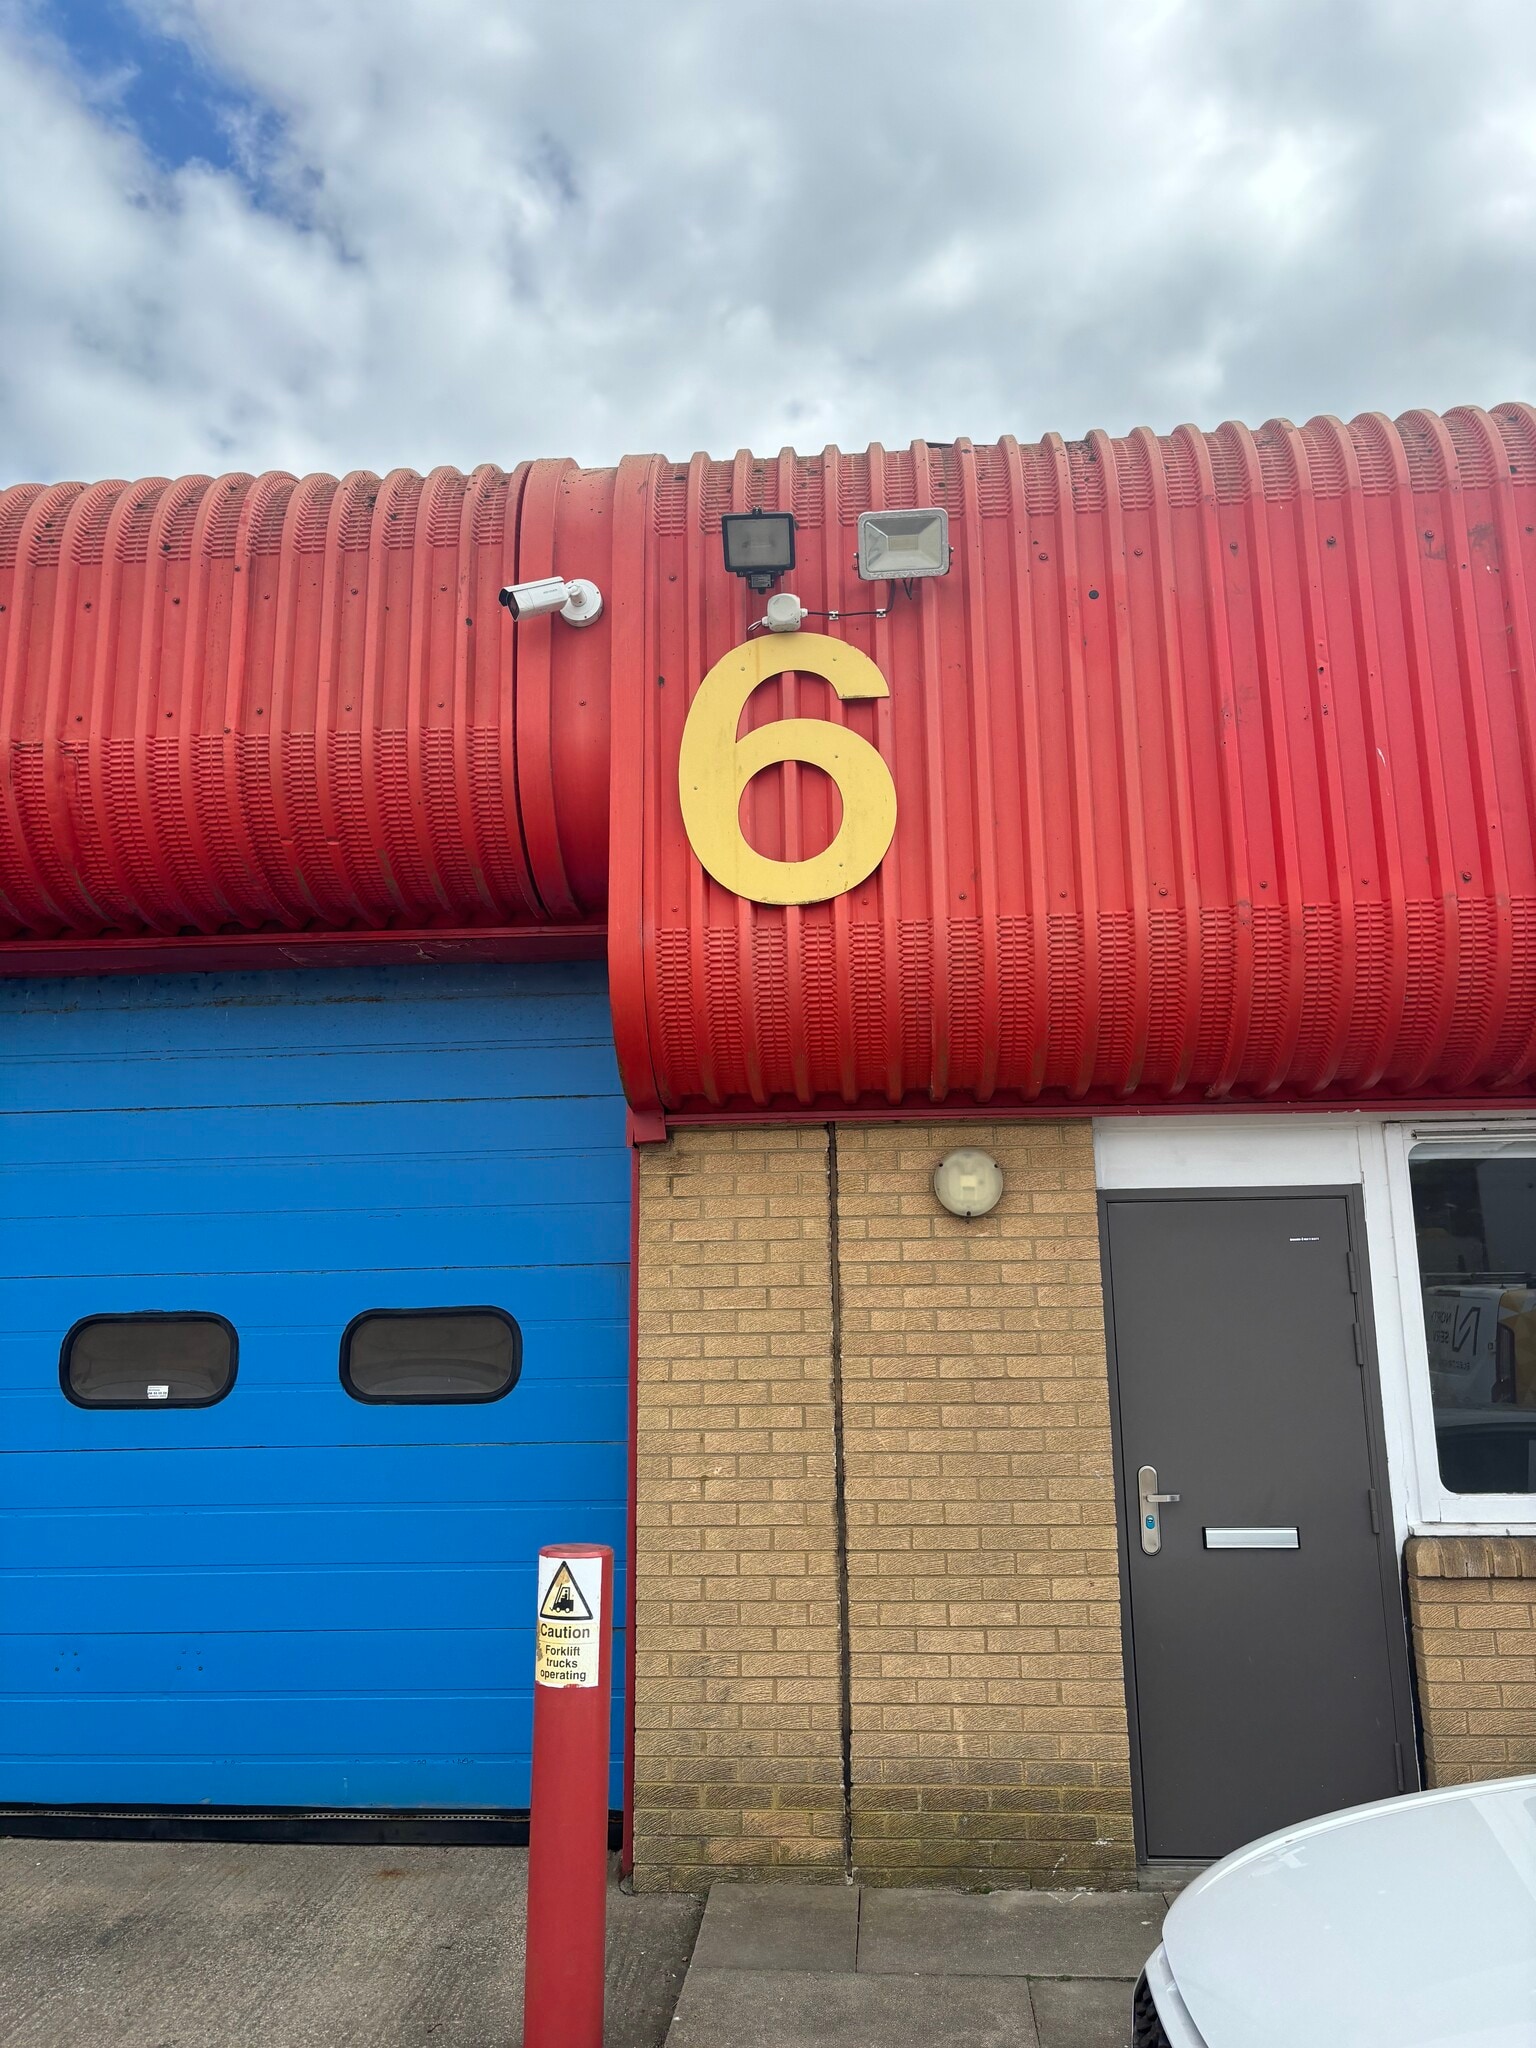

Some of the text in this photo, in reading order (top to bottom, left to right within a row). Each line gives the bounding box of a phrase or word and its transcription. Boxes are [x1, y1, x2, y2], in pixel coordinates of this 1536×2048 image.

[679, 631, 897, 906] 6
[540, 1623, 590, 1639] Caution
[545, 1644, 580, 1657] Forklift
[546, 1657, 578, 1668] trucks
[540, 1669, 587, 1682] operating
